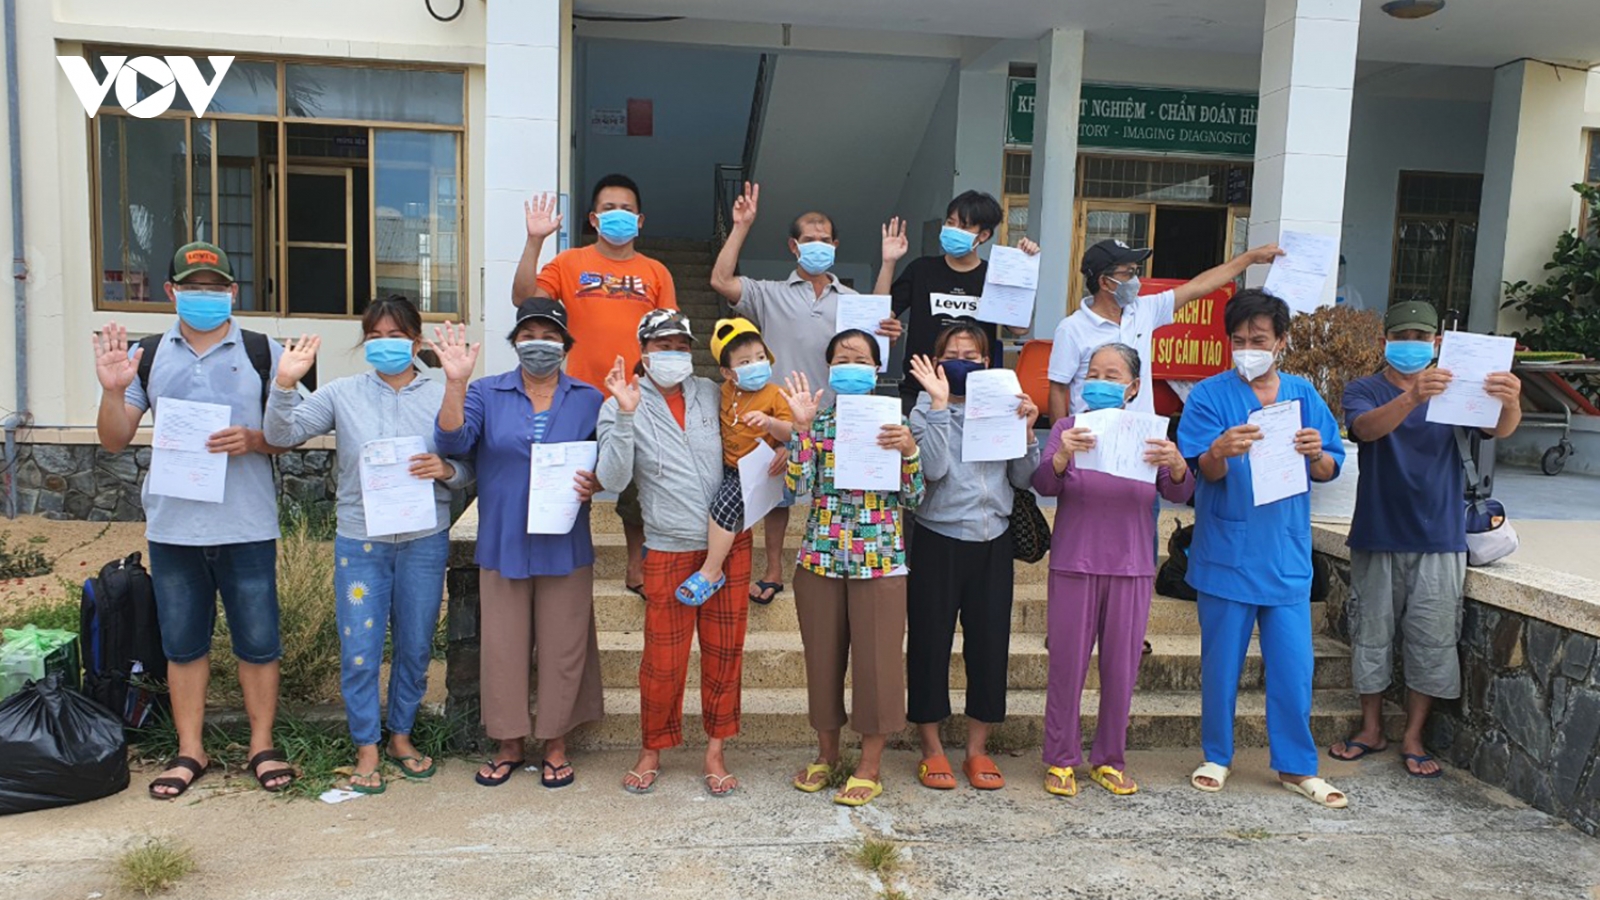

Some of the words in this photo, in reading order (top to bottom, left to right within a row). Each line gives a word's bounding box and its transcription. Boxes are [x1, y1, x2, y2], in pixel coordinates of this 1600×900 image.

[1091, 97, 1146, 122] NGHIỆM
[1158, 94, 1197, 122] CHẨN
[1199, 102, 1237, 124] ĐOÁN
[1239, 104, 1258, 126] HÌ
[1123, 126, 1176, 141] IMAGING
[1179, 128, 1252, 145] DIAGNOSTIC
[1201, 299, 1214, 325] LY
[1158, 336, 1175, 370] SỰ
[1175, 330, 1199, 365] CẤM
[1201, 335, 1222, 367] VÀO
